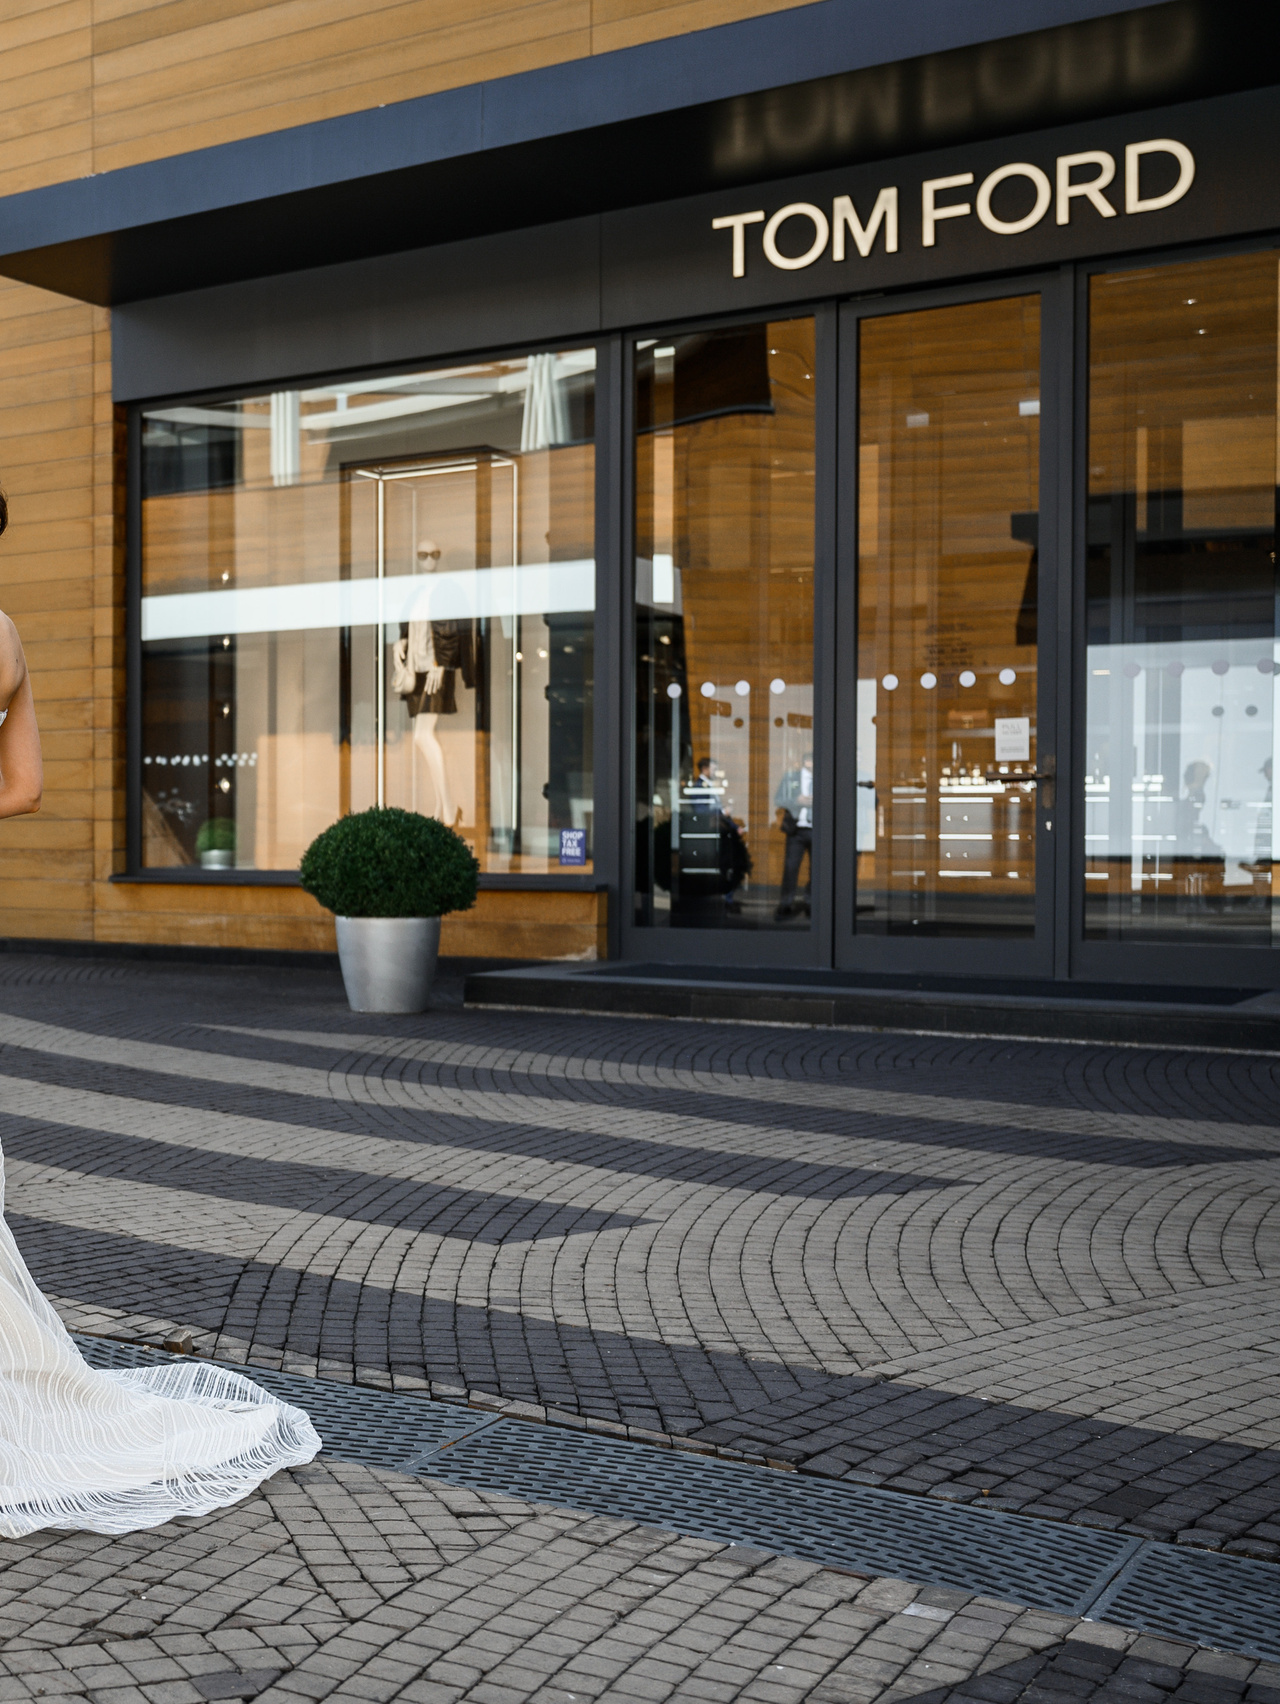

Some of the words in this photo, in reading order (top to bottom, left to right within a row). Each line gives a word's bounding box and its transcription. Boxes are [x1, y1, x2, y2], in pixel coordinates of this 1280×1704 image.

[711, 186, 899, 279] TOM
[921, 138, 1196, 248] FORD
[562, 830, 584, 840] SHOP
[562, 839, 578, 848] TAX
[561, 847, 581, 857] FREE
